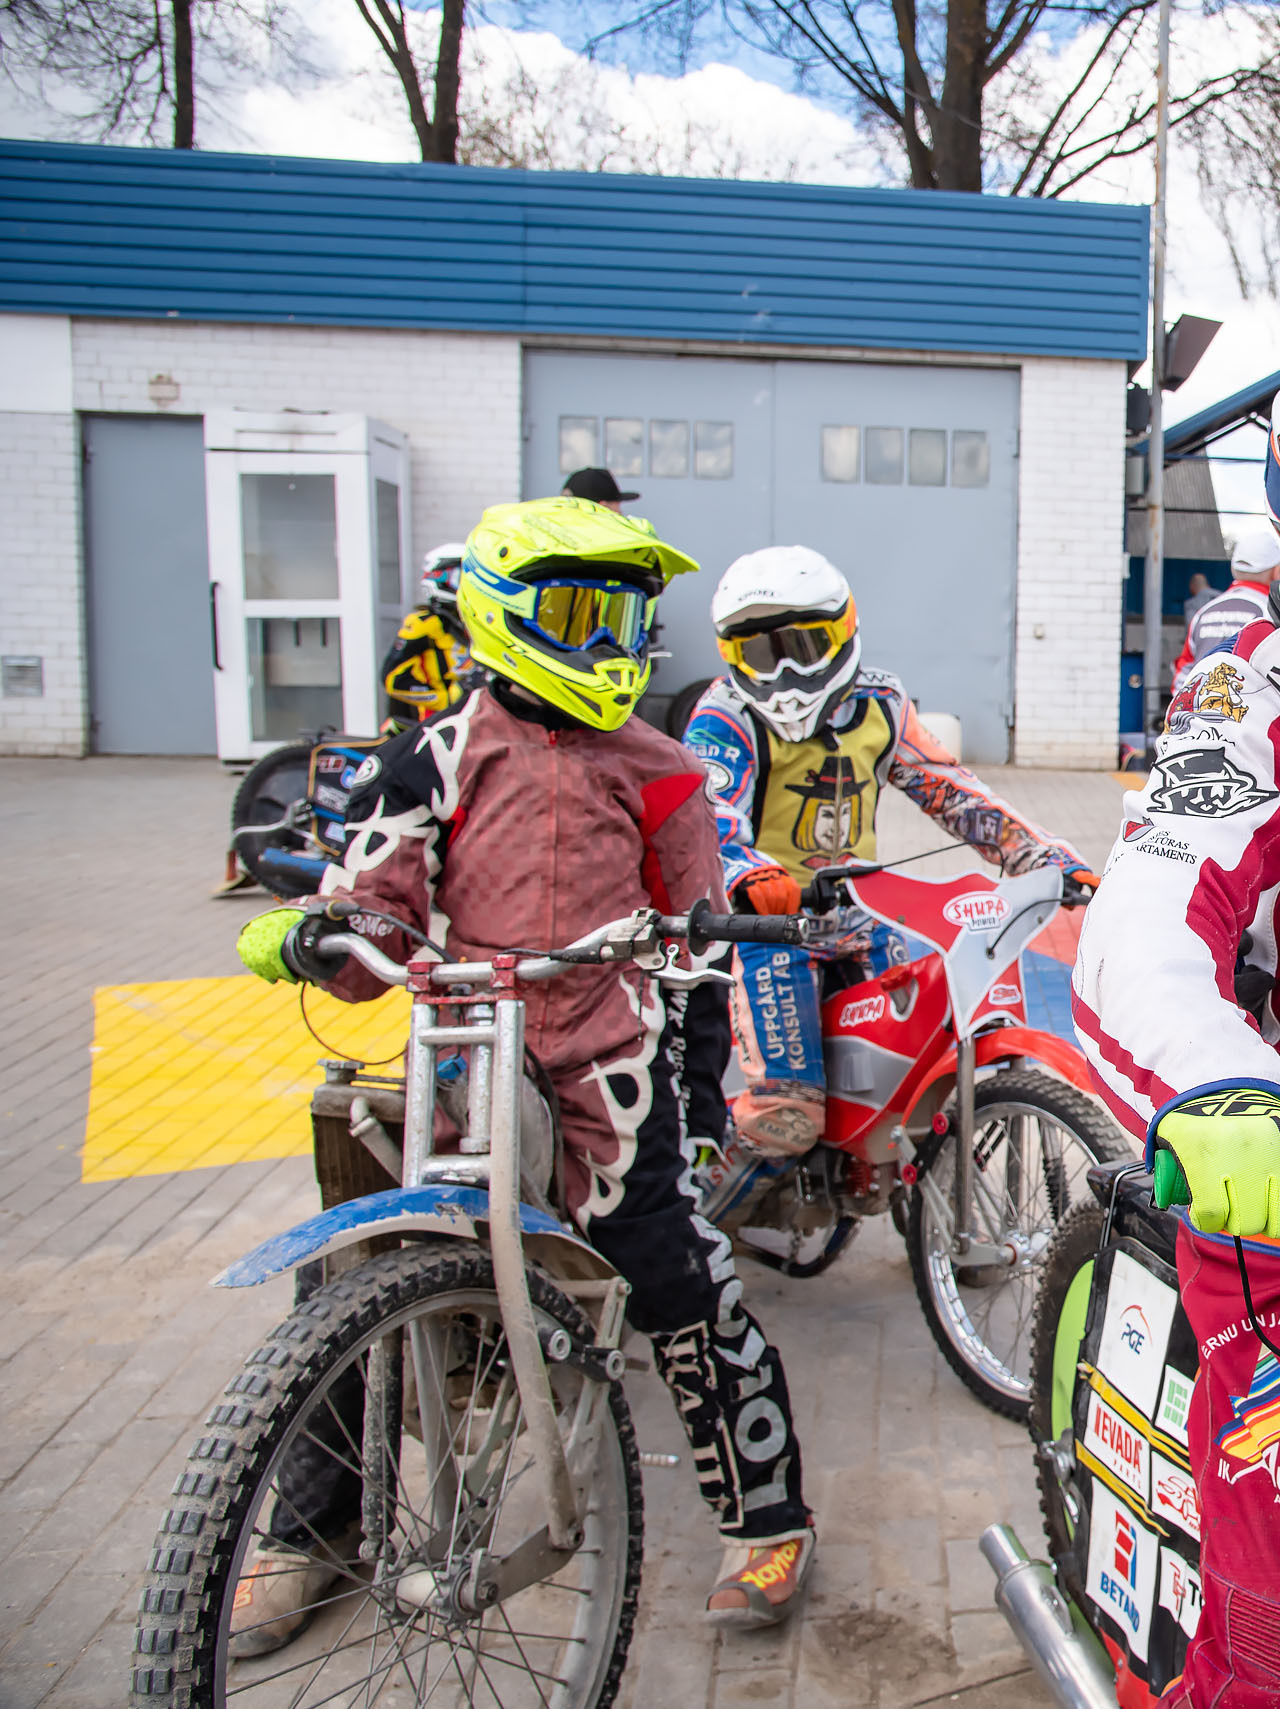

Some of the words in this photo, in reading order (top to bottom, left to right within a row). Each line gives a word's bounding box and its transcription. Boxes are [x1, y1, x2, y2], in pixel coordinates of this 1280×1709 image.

[952, 899, 1005, 920] SHUPA
[772, 951, 791, 980] AB
[777, 985, 807, 1070] KONSULT
[1120, 1322, 1145, 1355] PGE
